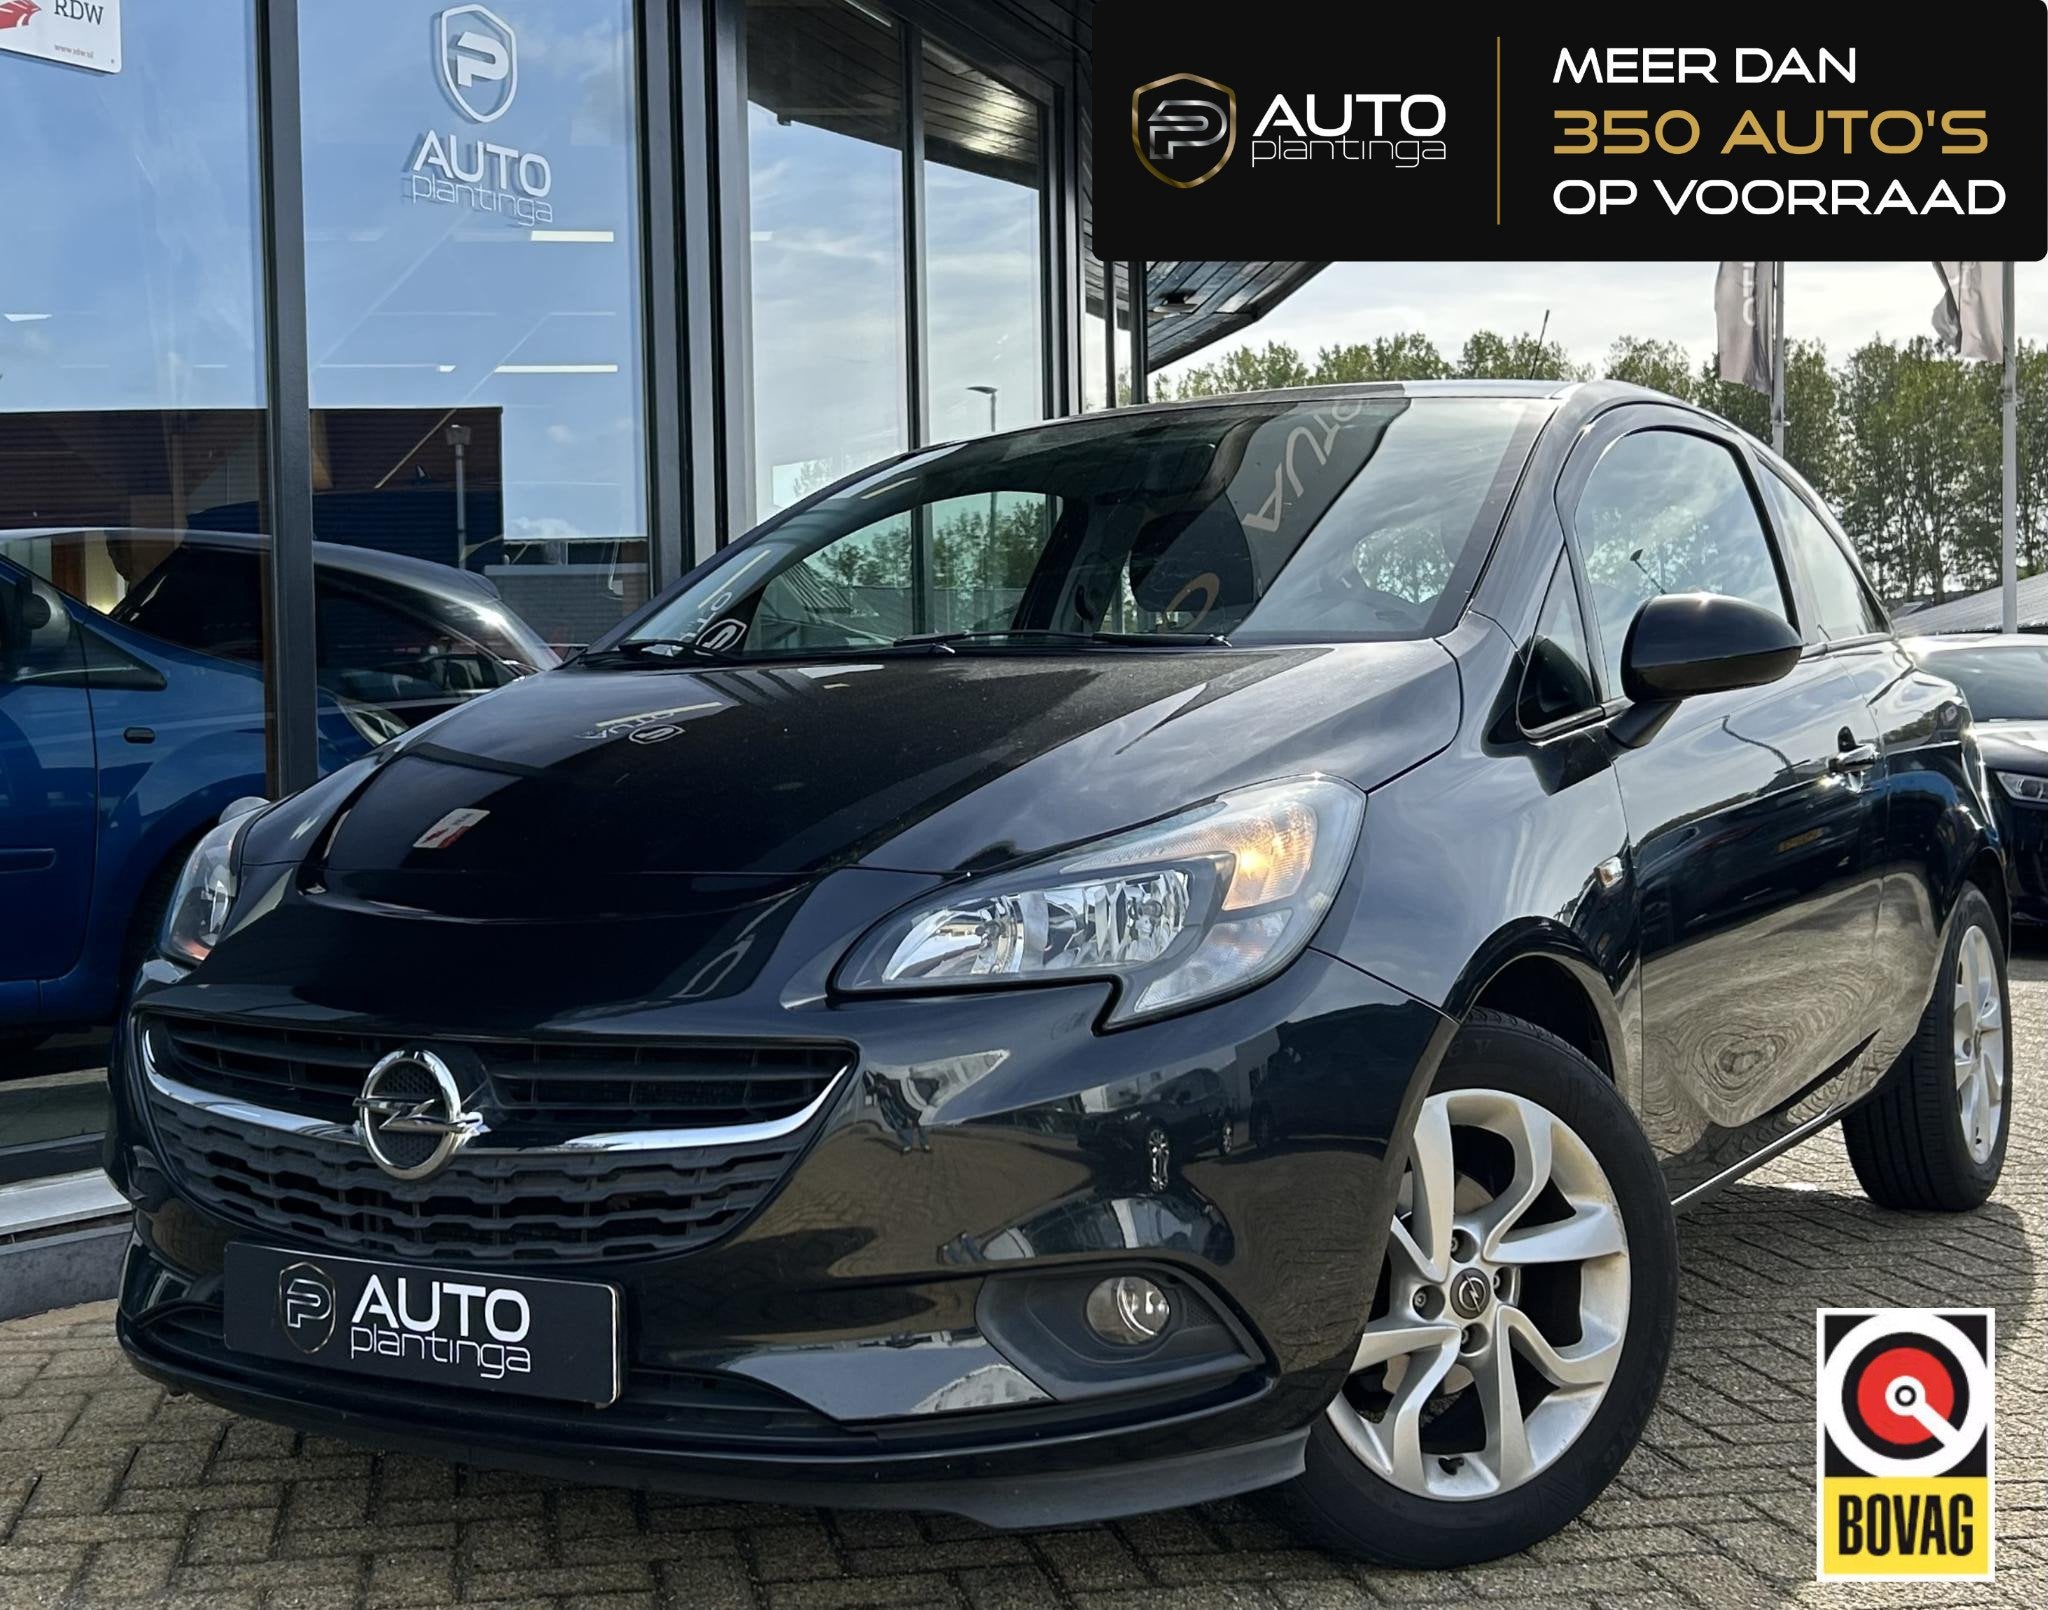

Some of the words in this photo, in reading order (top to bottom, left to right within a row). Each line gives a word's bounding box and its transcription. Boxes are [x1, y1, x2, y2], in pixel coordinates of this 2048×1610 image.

[54, 0, 104, 25] RDW
[412, 129, 551, 197] AUTO
[412, 174, 553, 227] plantinga
[351, 1274, 531, 1343] AUTO
[351, 1322, 531, 1379] plantinga
